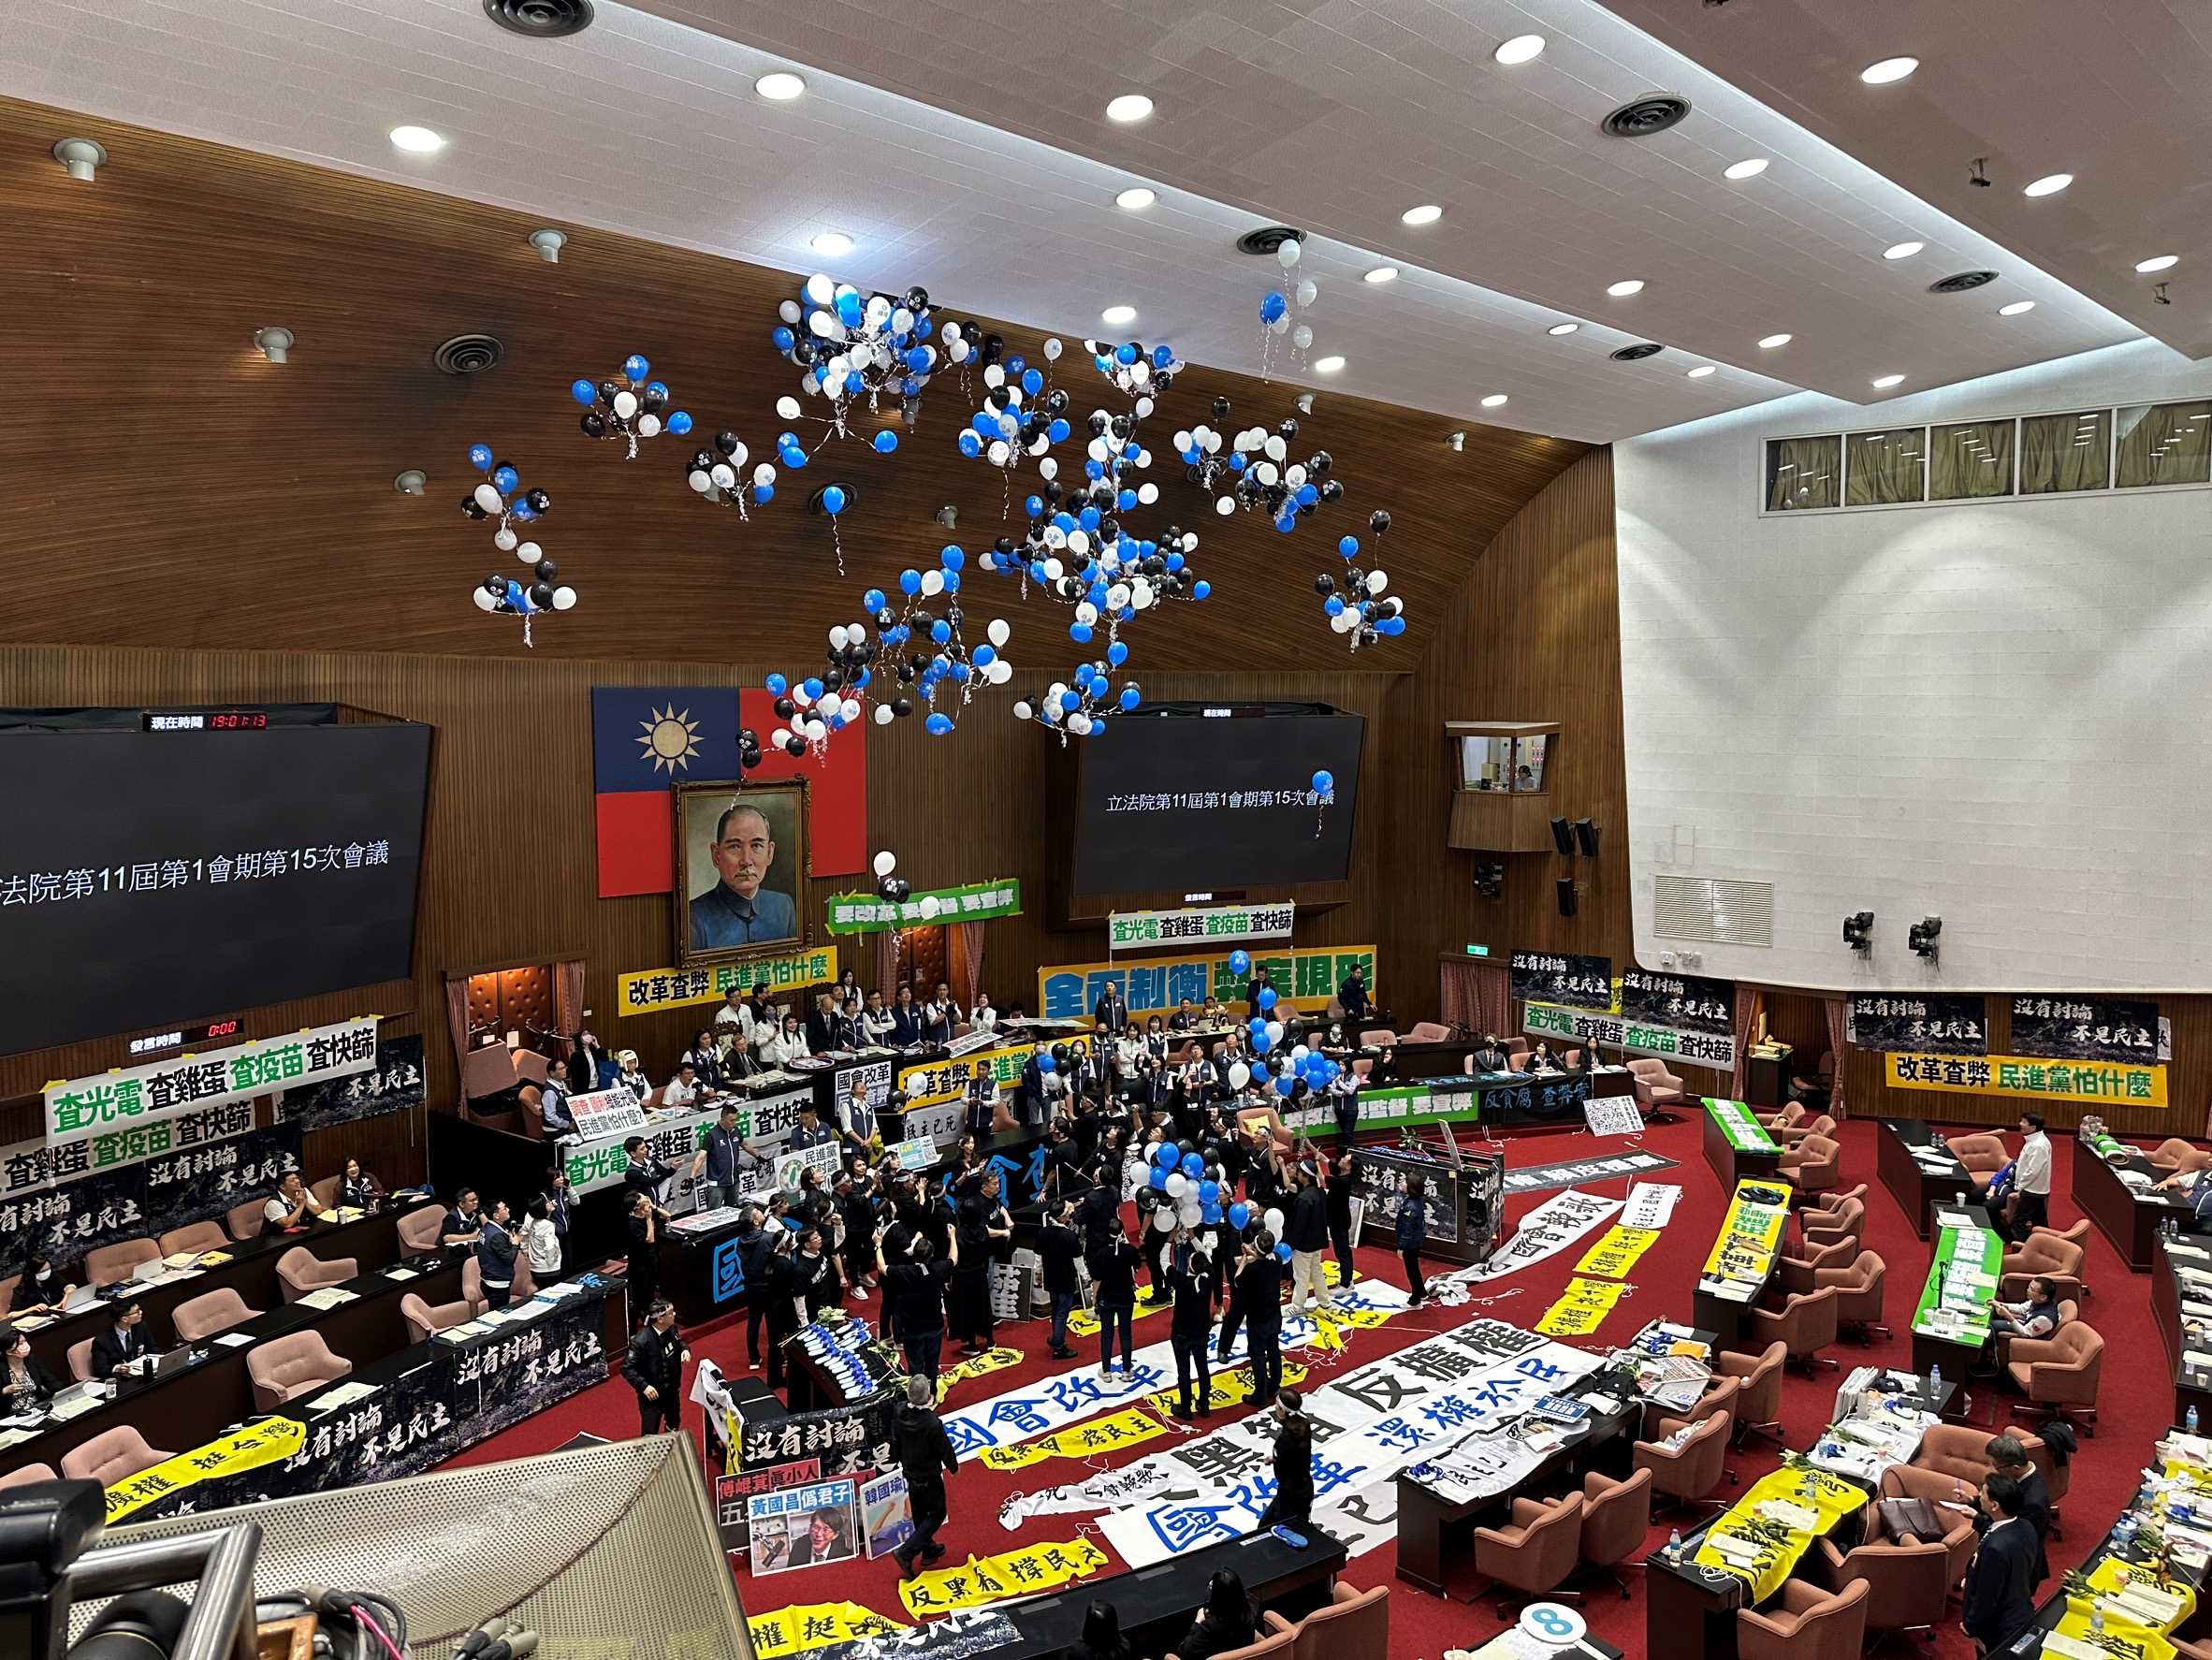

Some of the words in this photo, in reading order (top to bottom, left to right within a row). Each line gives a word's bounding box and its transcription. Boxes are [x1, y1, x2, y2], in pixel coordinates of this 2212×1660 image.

[151, 715, 204, 729] 現在時間
[1531, 1608, 1574, 1636] 8
